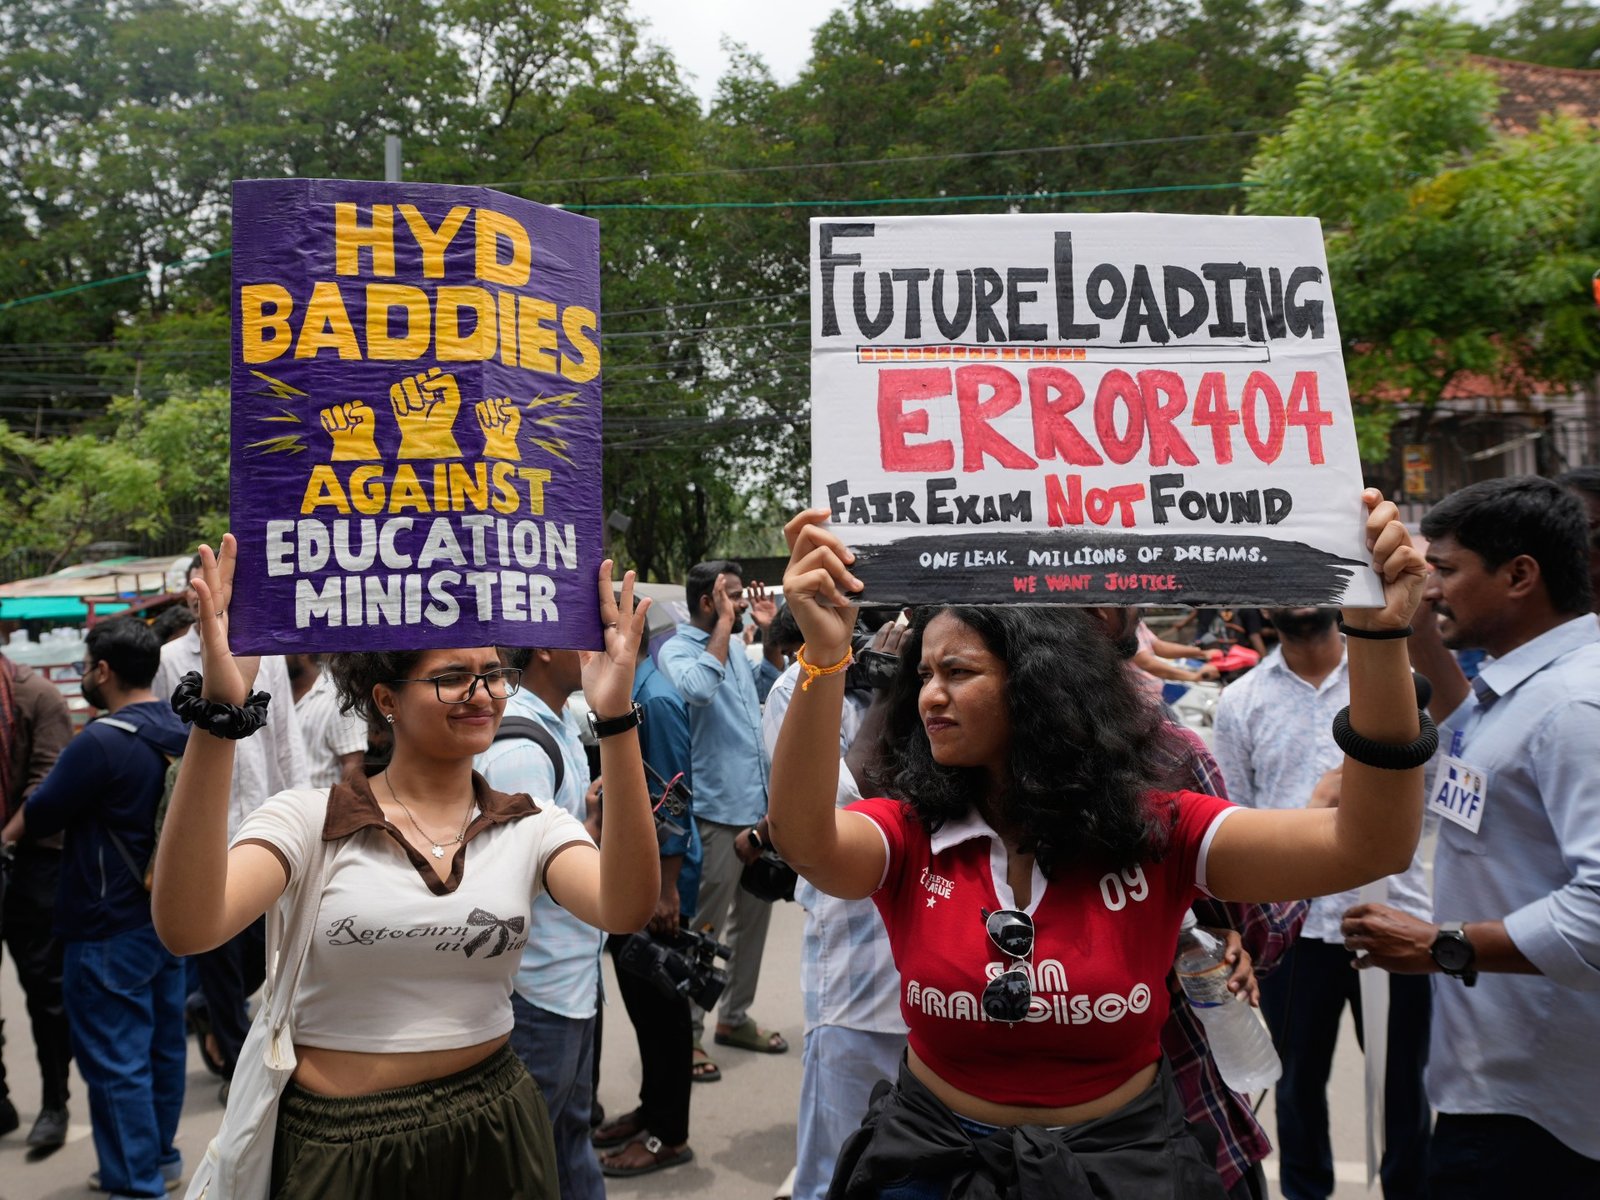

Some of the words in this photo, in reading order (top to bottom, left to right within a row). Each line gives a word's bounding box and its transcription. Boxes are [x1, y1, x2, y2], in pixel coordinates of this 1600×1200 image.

[334, 202, 531, 287] HYD
[819, 223, 1048, 342] FUTURE
[1054, 231, 1324, 345] LOADING
[241, 282, 600, 383] BADDIES
[877, 364, 1199, 472] ERROR
[1192, 370, 1333, 465] 404
[300, 462, 551, 515] AGAINST
[826, 480, 920, 524] FAIR
[926, 477, 1031, 525] EXAM
[1045, 474, 1145, 528] NOT
[1149, 473, 1293, 525] FOUND
[266, 514, 578, 577] EDUCATION
[919, 551, 960, 570] ONE
[964, 549, 1015, 567] LEAK.
[1027, 546, 1126, 567] MILLIONS
[1137, 546, 1163, 563] OF
[1174, 546, 1268, 564] DREAMS.
[295, 569, 559, 629] MINISTER
[1013, 575, 1036, 593] WE
[1045, 574, 1092, 592] WANT
[1104, 572, 1184, 591] JUSTICE.
[1436, 781, 1481, 819] AIYF
[1100, 863, 1149, 911] 09
[907, 980, 1151, 1025] FRACISCO
